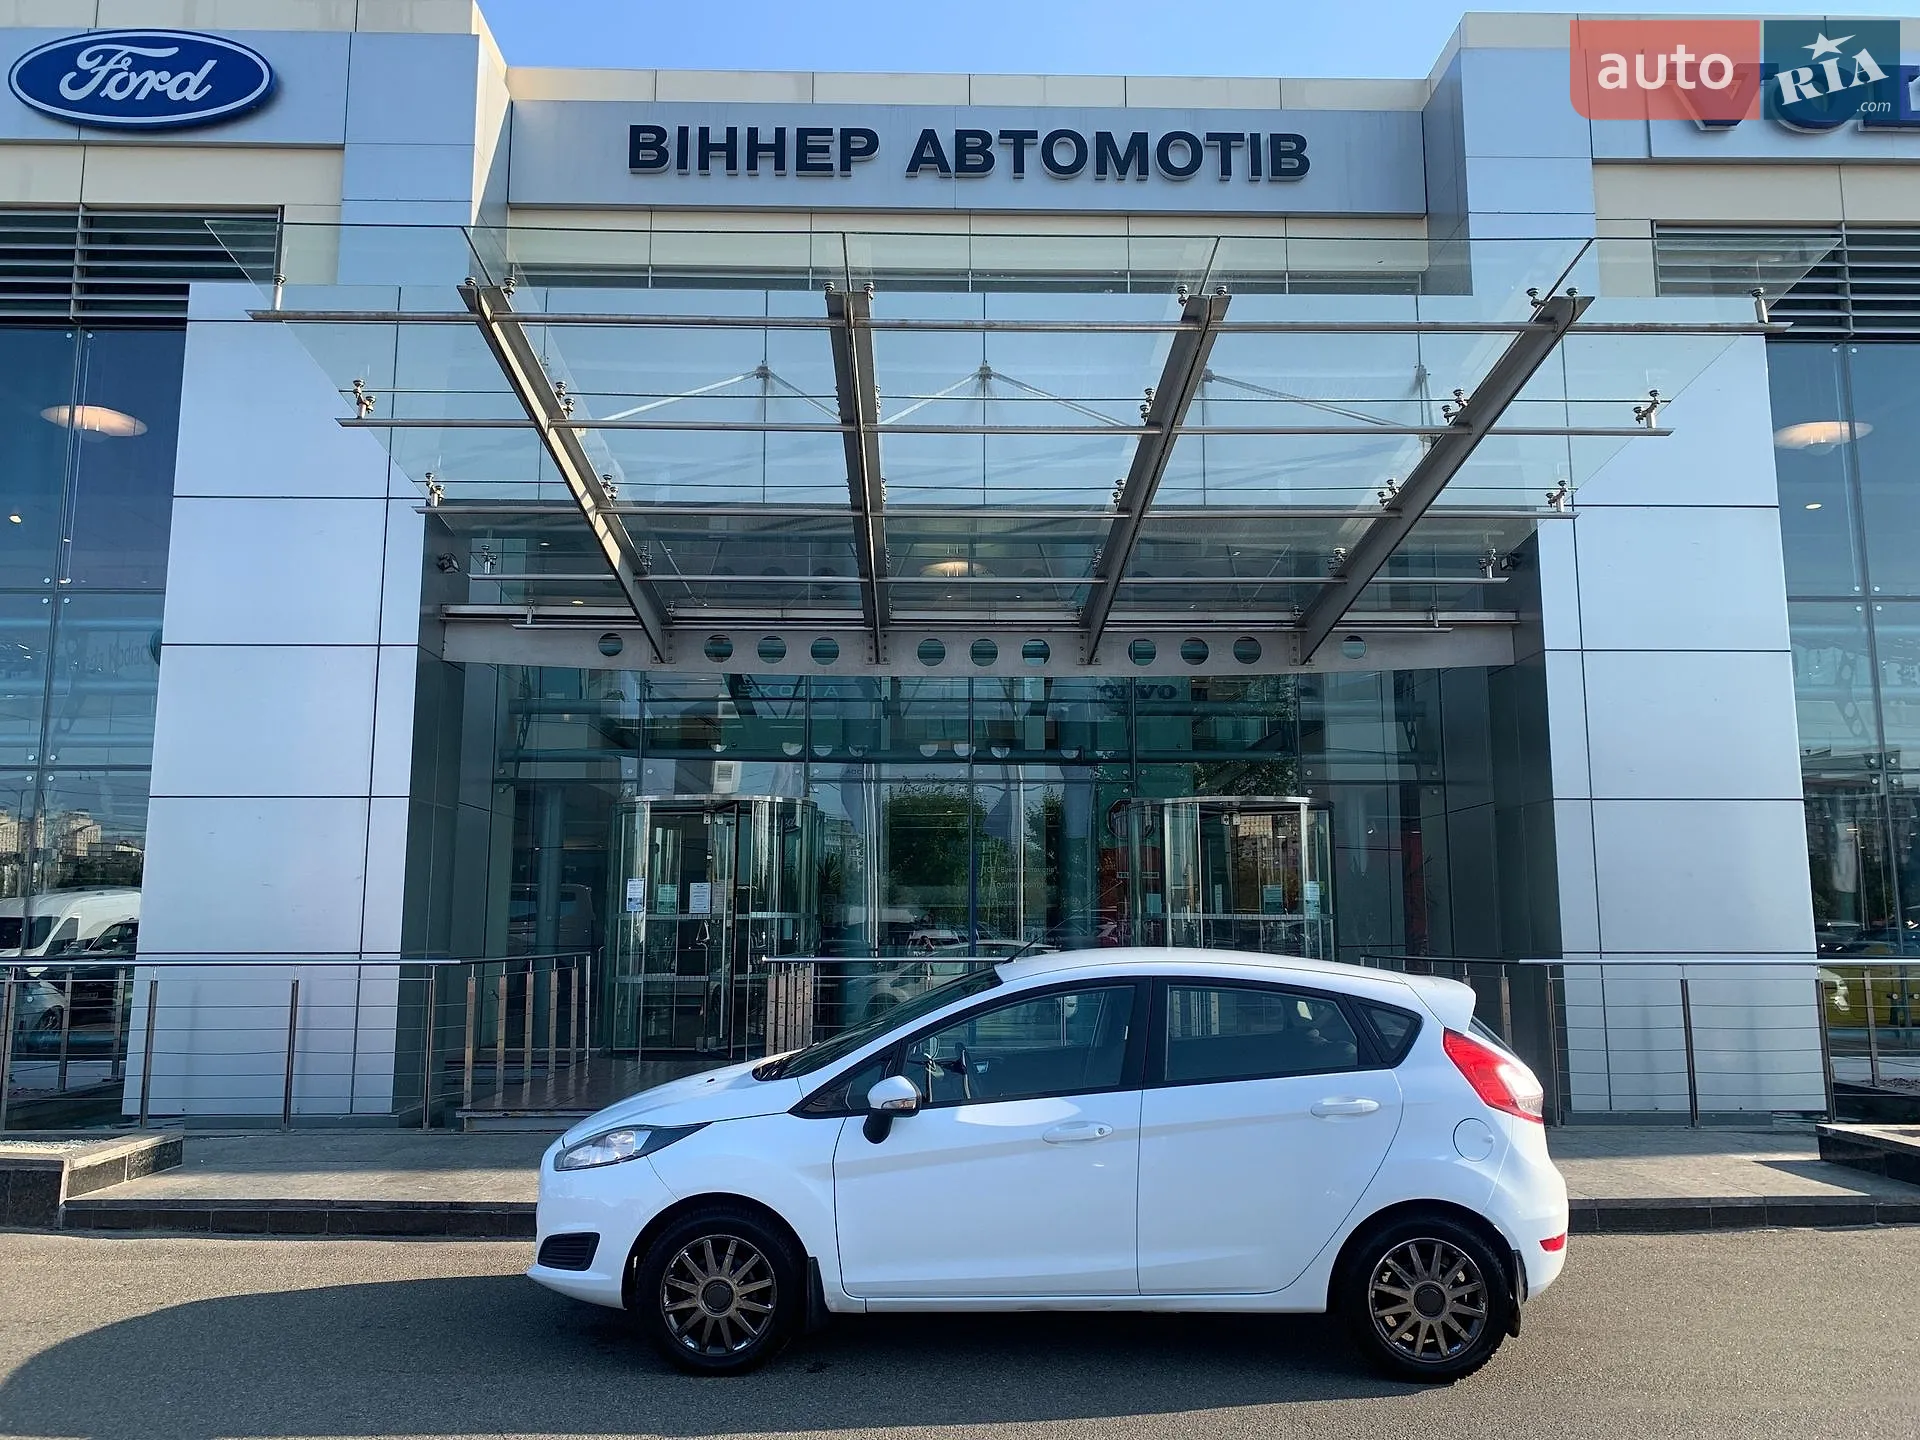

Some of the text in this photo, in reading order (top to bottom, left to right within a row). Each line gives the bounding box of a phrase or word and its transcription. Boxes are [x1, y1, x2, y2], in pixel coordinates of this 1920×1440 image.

[59, 44, 217, 102] Ford
[627, 124, 1311, 182] ВІННЕР АВТОМОТІВ
